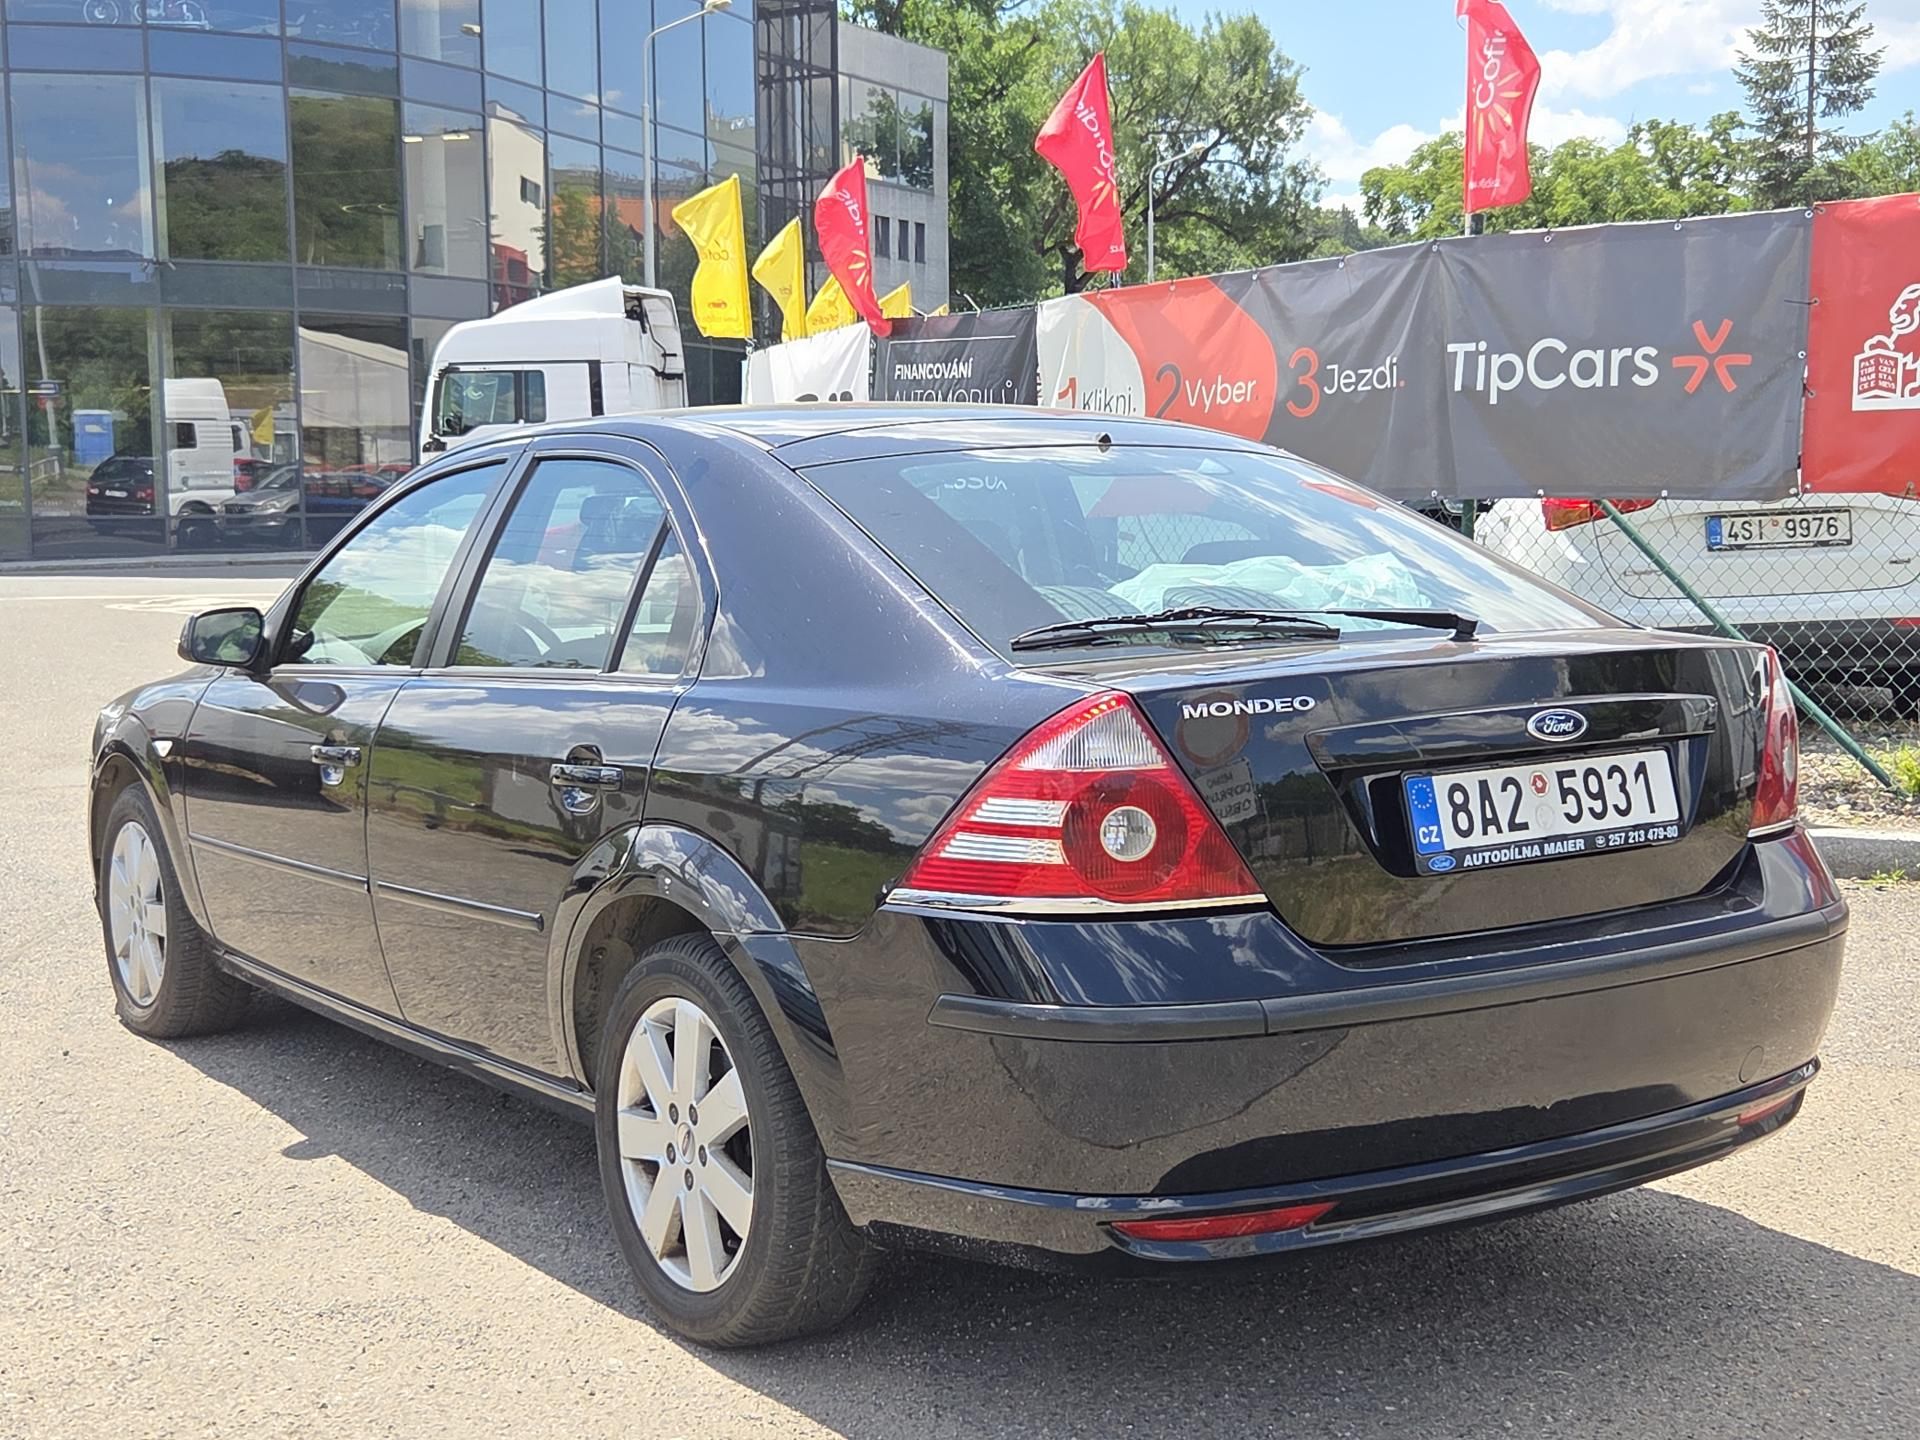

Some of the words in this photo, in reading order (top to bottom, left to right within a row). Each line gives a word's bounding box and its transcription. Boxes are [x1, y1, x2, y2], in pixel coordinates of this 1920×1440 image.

[894, 357, 974, 381] FINANCOVÁNÍ
[1286, 347, 1320, 417] 3
[1447, 338, 1659, 404] TipCars
[1058, 377, 1077, 409] 1
[1155, 362, 1183, 422] 2
[1785, 516, 1839, 539] 9976
[1182, 695, 1316, 720] MONDEO
[1542, 714, 1575, 734] Ford
[1447, 776, 1530, 839] 8A2
[1555, 760, 1656, 825] 5931
[1418, 826, 1441, 845] CZ
[1463, 844, 1541, 868] AUTODÍLNA
[1543, 838, 1585, 856] MAIER
[1608, 832, 1626, 846] 257
[1628, 830, 1646, 844] 213
[1647, 825, 1679, 842] 479-80
